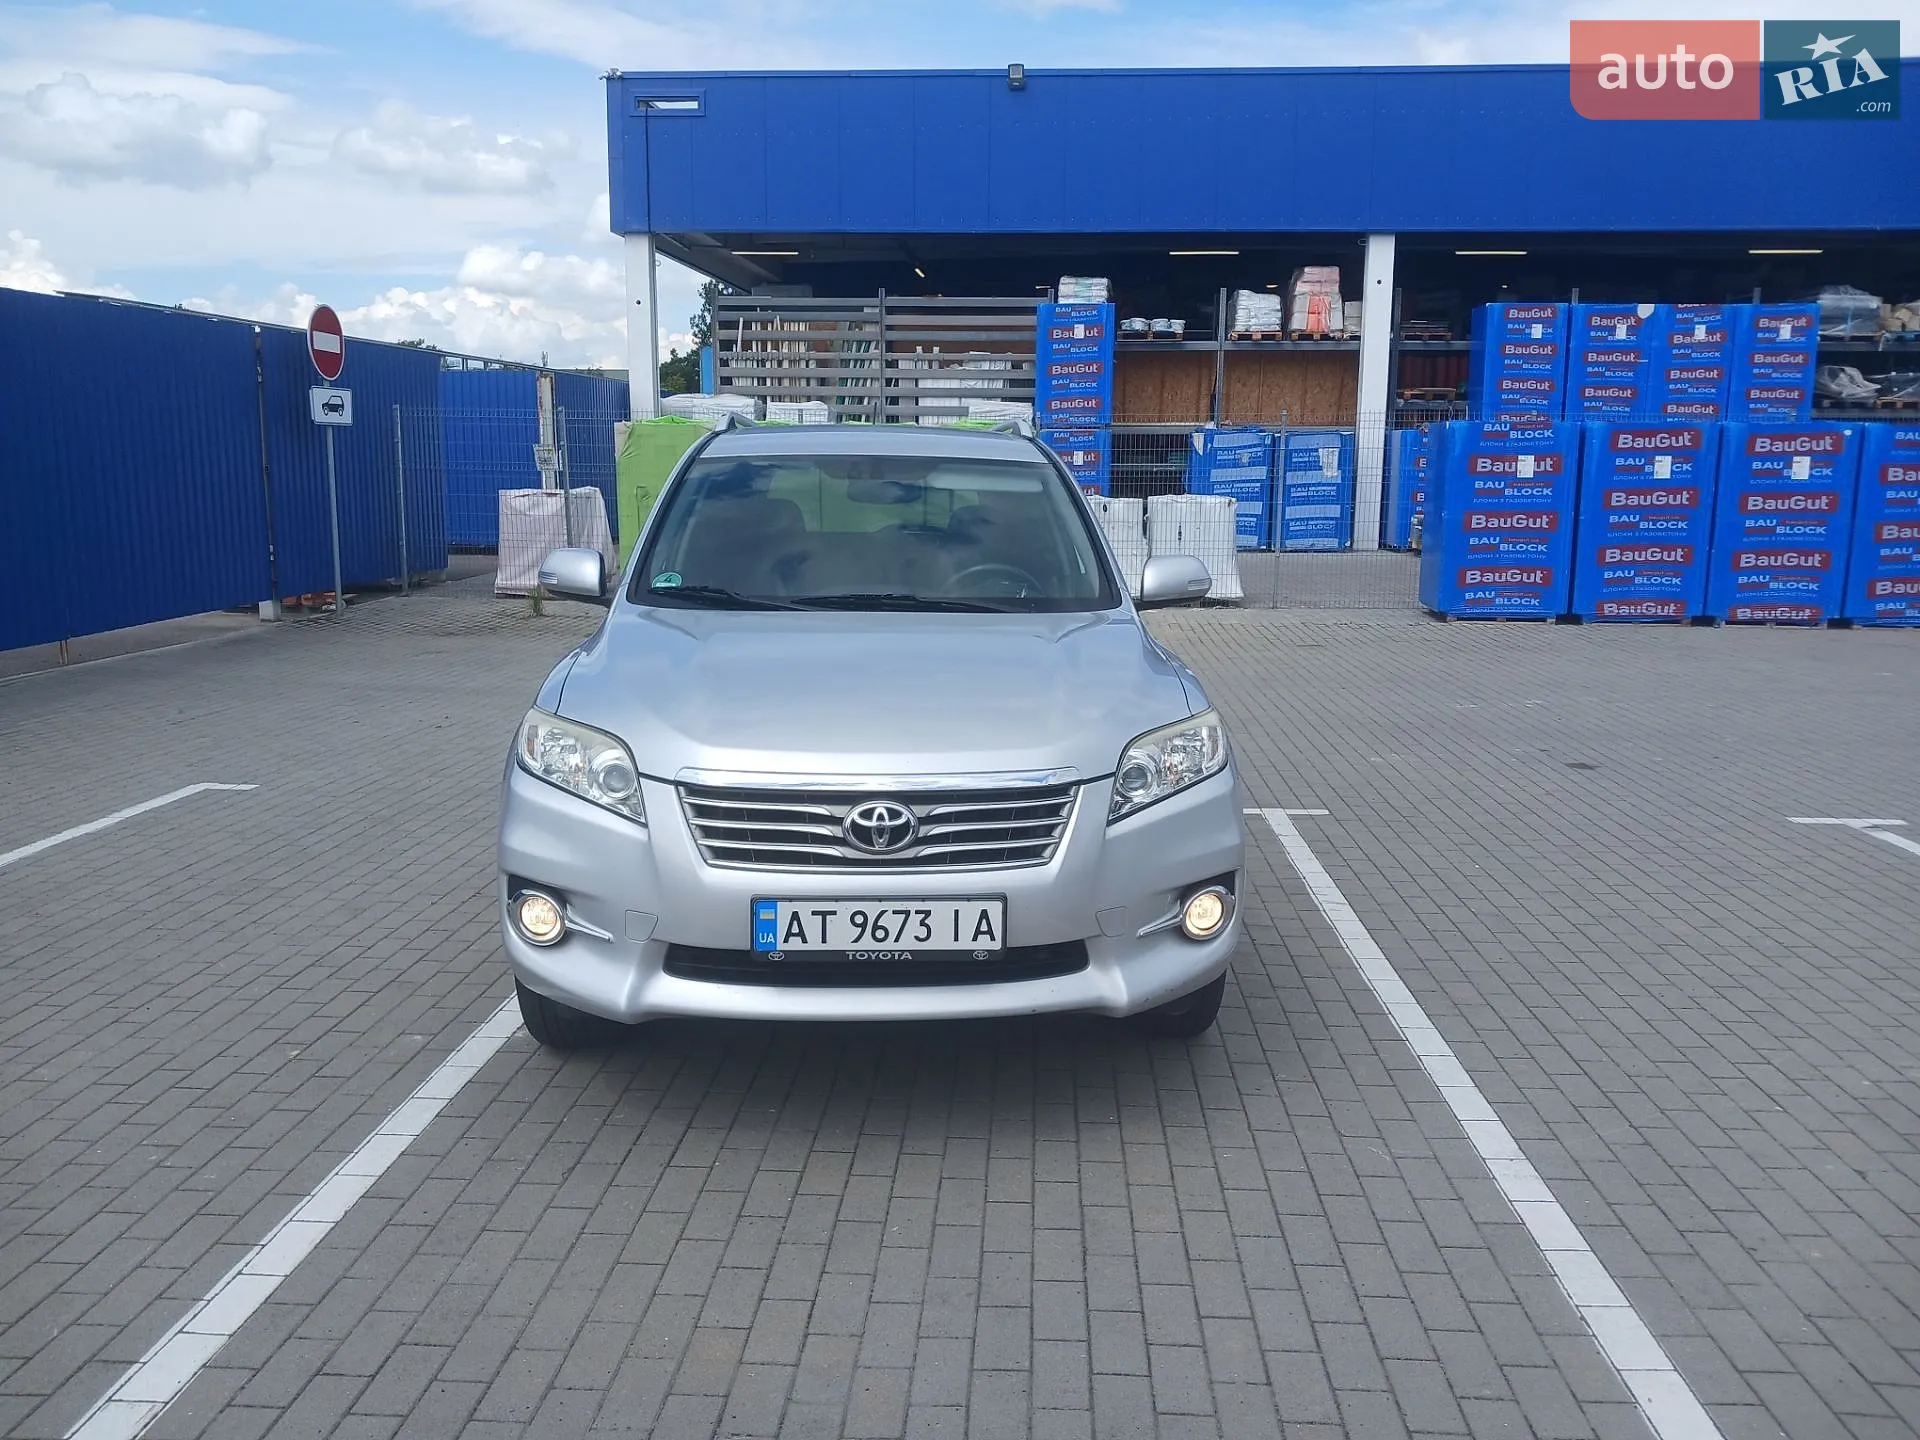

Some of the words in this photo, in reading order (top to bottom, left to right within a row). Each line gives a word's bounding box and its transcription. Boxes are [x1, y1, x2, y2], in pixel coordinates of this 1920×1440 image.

[1509, 308, 1552, 318] BauGut
[1592, 317, 1636, 326] BauGut
[1053, 328, 1098, 338] Bauut
[1505, 345, 1552, 354] BauGut
[1588, 353, 1635, 362] BauGut
[1754, 354, 1804, 363] BauGut
[1052, 364, 1098, 374] BauGut
[1671, 370, 1718, 379] BauGut
[1503, 381, 1550, 390] BauGut
[1585, 389, 1632, 397] BauGut
[1751, 390, 1800, 399] BauGut
[1051, 399, 1097, 409] BauGut
[1667, 405, 1713, 414] BauGut
[1510, 430, 1554, 439] BLOCK
[1618, 432, 1692, 448] BauGut
[1755, 436, 1832, 452] BauGut
[1477, 458, 1553, 472] Bauut
[1645, 463, 1693, 472] BCK
[1784, 468, 1832, 476] BCK
[1611, 491, 1690, 506] BauGut
[1748, 496, 1829, 510] BauGut
[1471, 516, 1549, 528] BauGut
[1605, 548, 1684, 562] BauGut
[1740, 553, 1821, 567] BauGut
[1465, 570, 1543, 583] BauGut
[1604, 570, 1634, 578] BAU
[1634, 577, 1681, 585] BLOCK
[1738, 575, 1770, 583] BAU
[1769, 582, 1820, 590] BLOCK
[1876, 582, 1920, 595] Bau
[1465, 591, 1495, 600] BAU
[1604, 602, 1677, 616] BauGut
[1876, 602, 1906, 610] BAU
[1737, 608, 1811, 619] BauGut
[783, 910, 836, 944] AT
[850, 909, 932, 943] 9673
[954, 909, 996, 942] IA
[759, 933, 775, 943] UA
[846, 952, 912, 960] TOYOTA
